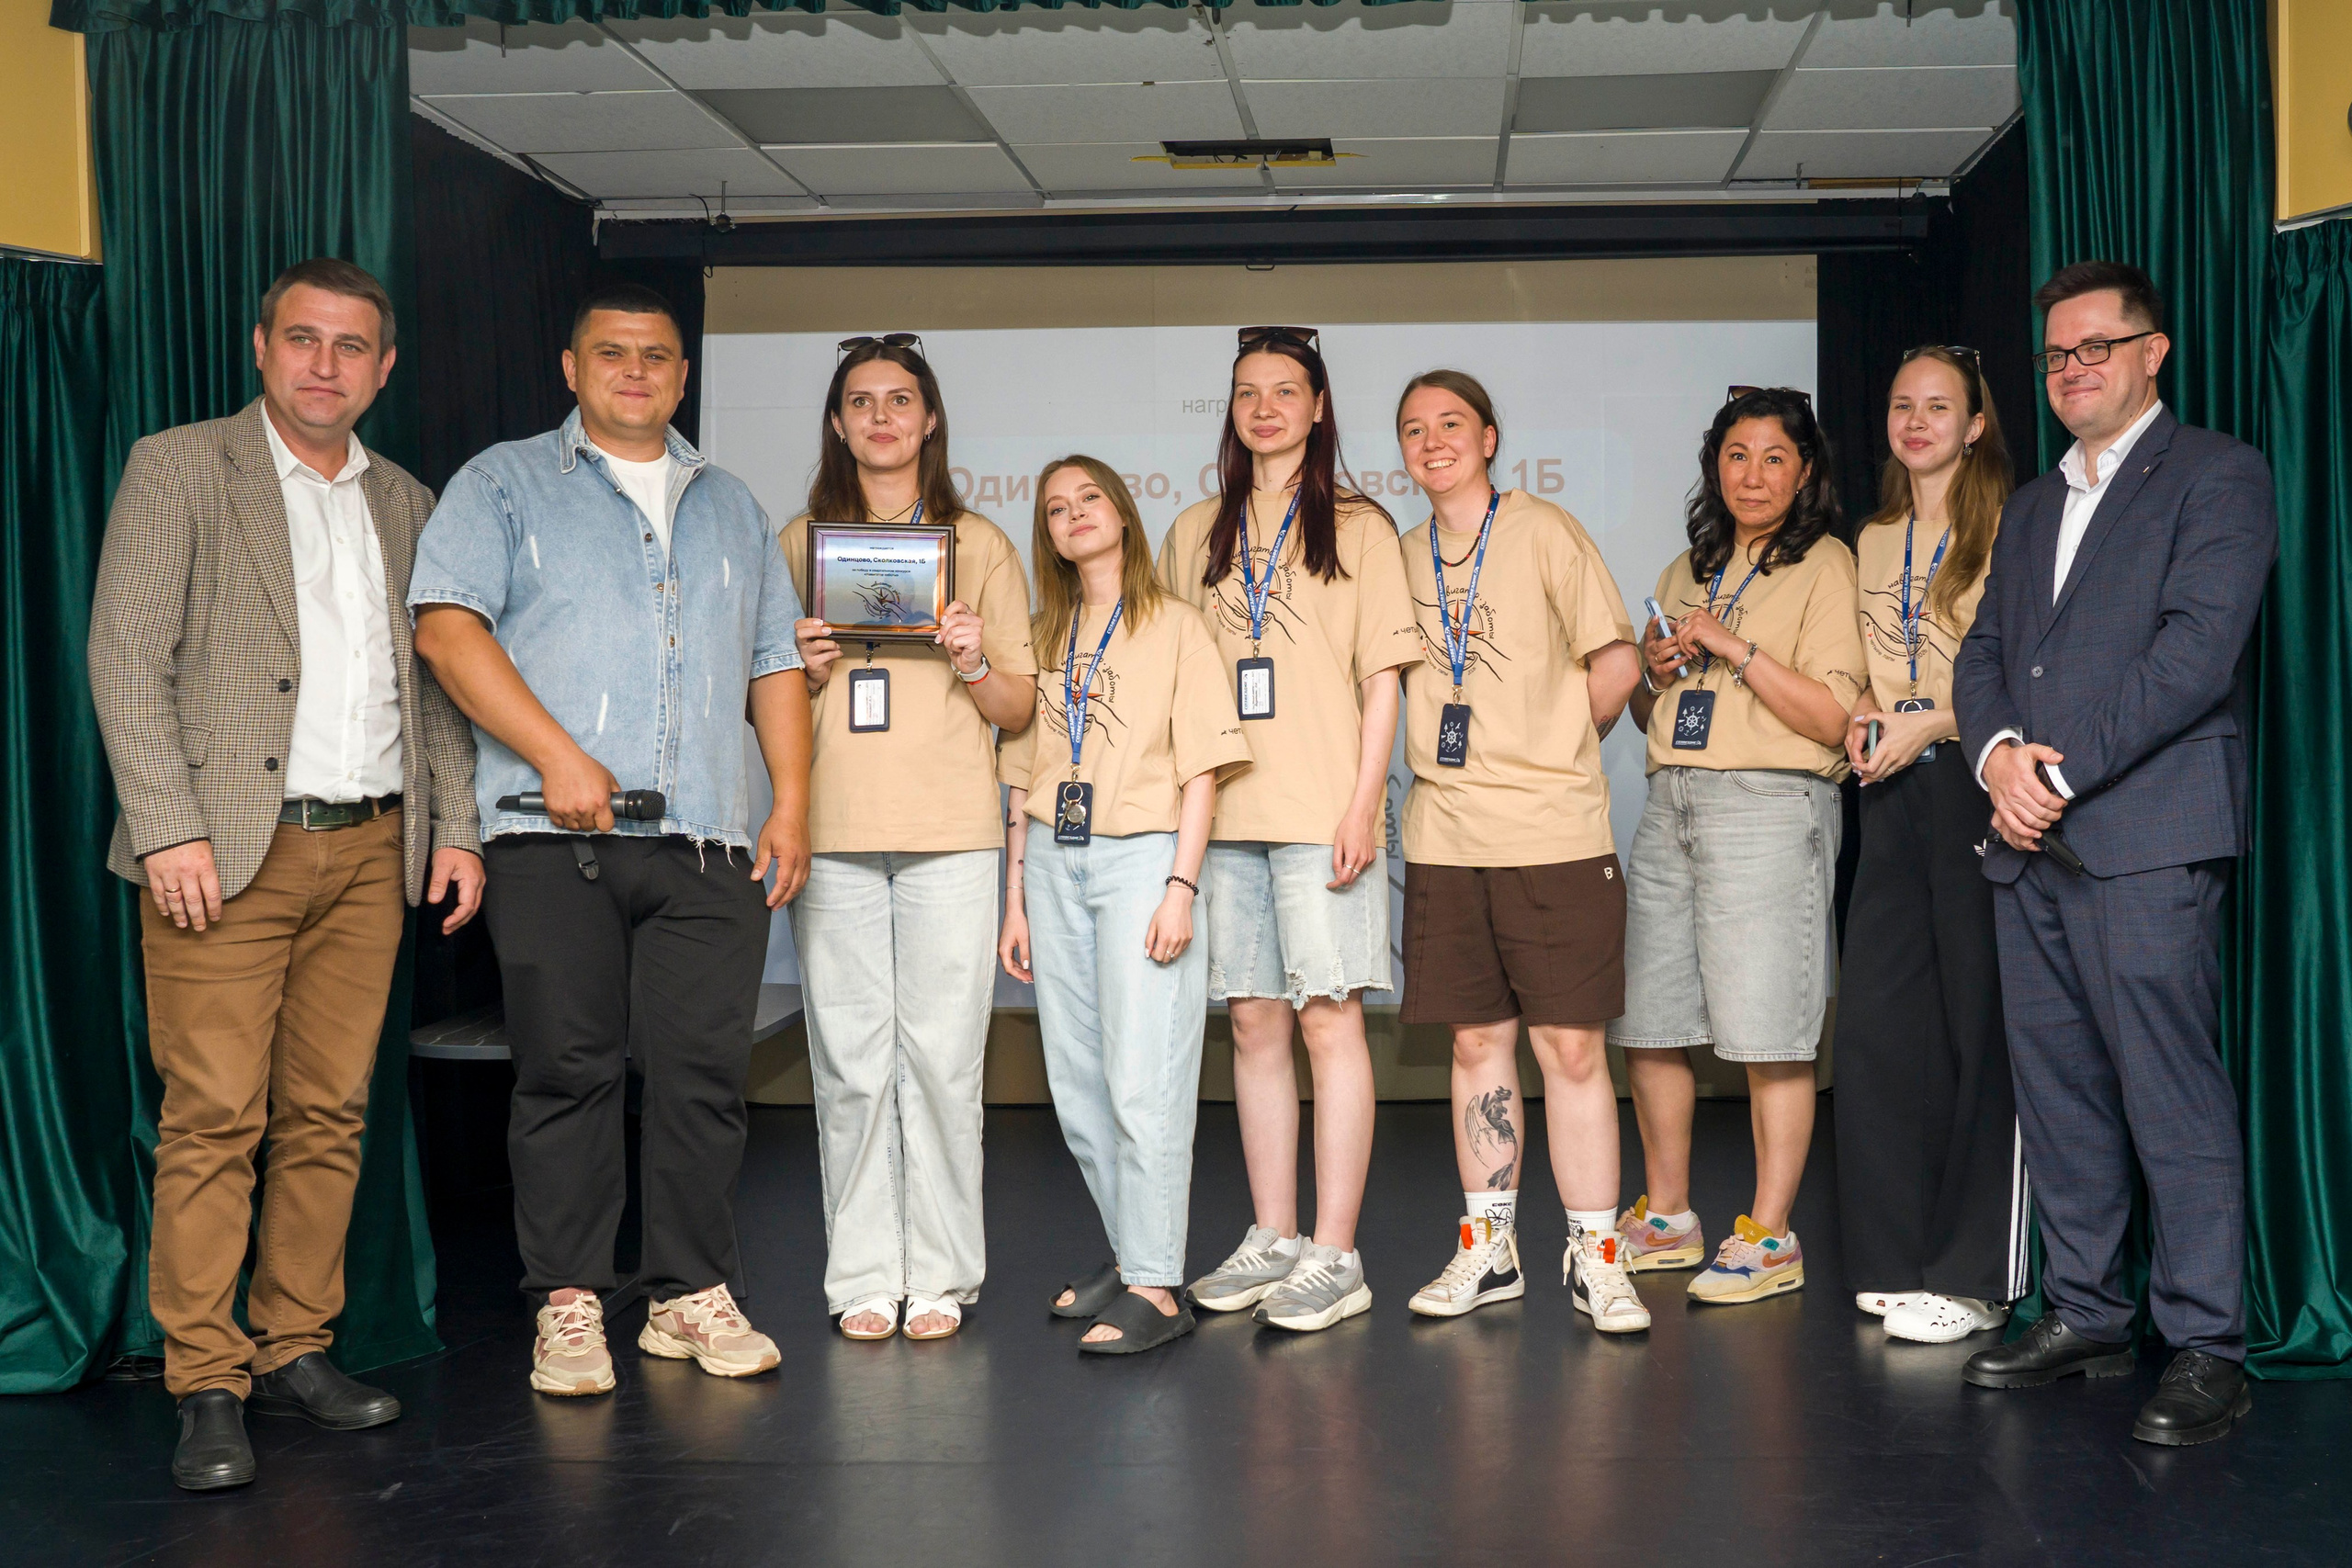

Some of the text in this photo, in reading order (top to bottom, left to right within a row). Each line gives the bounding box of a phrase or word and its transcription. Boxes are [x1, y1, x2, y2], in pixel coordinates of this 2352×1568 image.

[946, 467, 1182, 507] Одиво,
[1511, 458, 1565, 494] 1Б
[1478, 518, 1491, 549] СОЗВЕЗДИЕ
[1268, 536, 1282, 565] СОЗВЕЗДИЕ
[1278, 562, 1297, 600] заботы
[1437, 580, 1445, 610] СОЗВЕЗДИЕ
[1466, 574, 1477, 606] СОЗВЕЗДИЕ
[1106, 606, 1121, 634] СОЗВЕЗДИЕ
[1255, 589, 1266, 621] СОЗВЕЗДИЕ
[1480, 602, 1496, 639] заботы
[1456, 631, 1467, 663] СОЗВЕЗДИЕ
[1085, 655, 1099, 686] СОЗВЕЗДИЕ
[1102, 666, 1120, 703] заботы
[1075, 710, 1084, 743] СОЗВЕЗДИЕ
[1930, 1313, 1974, 1335] crocs
